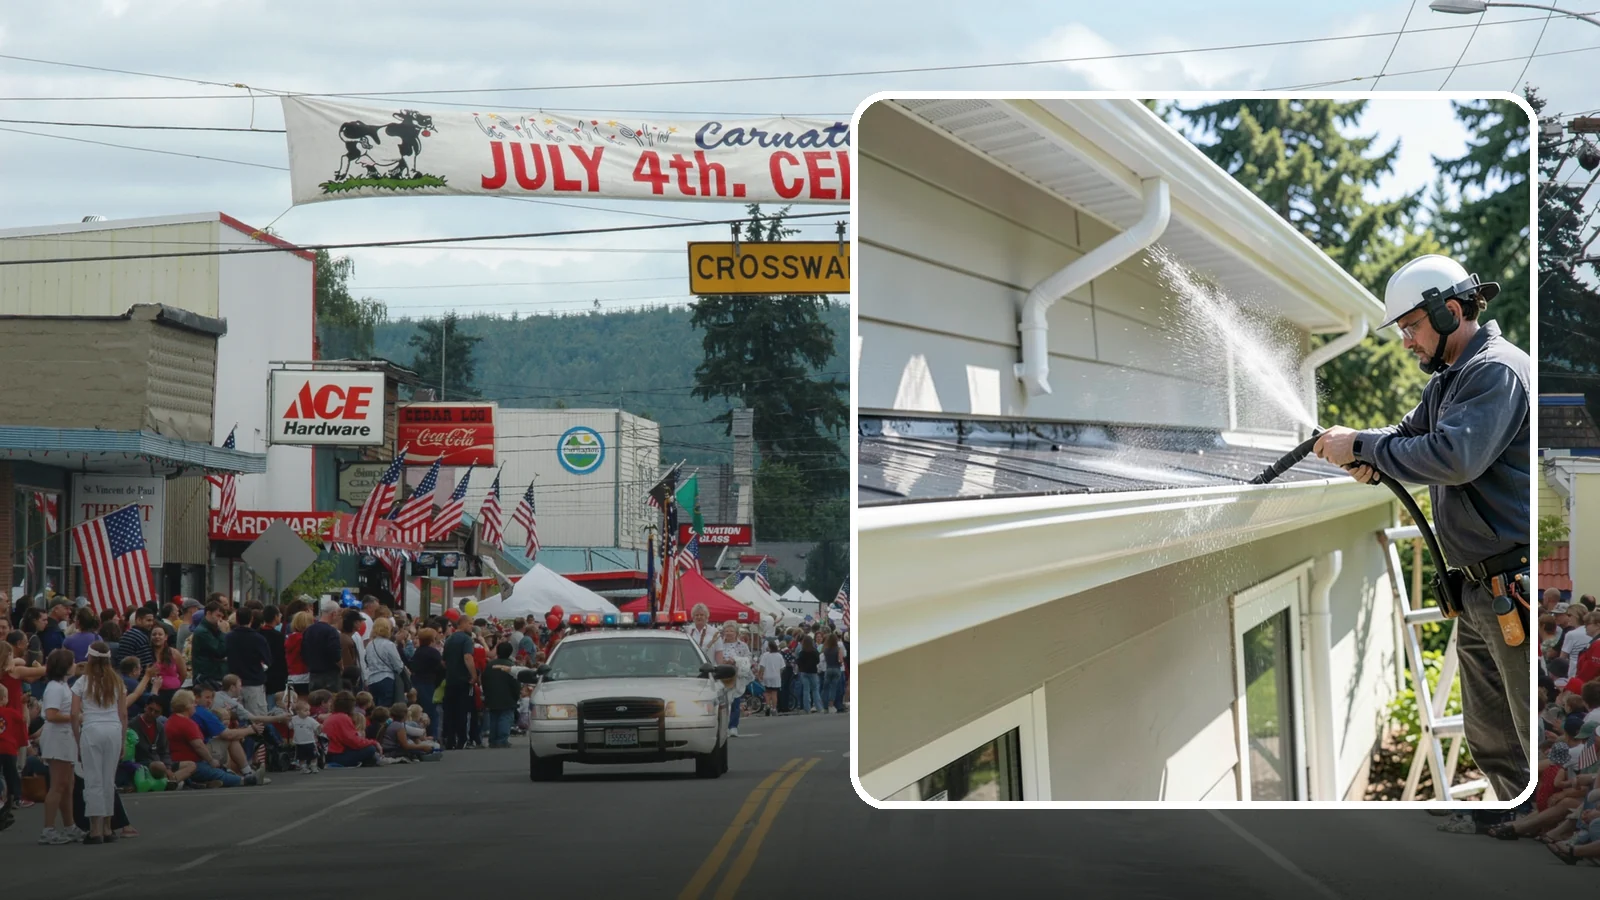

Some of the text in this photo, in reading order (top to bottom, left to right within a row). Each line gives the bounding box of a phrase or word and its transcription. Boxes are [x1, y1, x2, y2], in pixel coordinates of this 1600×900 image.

[481, 141, 604, 192] JULY
[632, 150, 746, 197] 4th.
[696, 254, 850, 280] CROSSWA
[283, 380, 373, 420] ACE
[405, 409, 453, 422] CEDAR
[283, 421, 371, 437] Hardware
[416, 428, 477, 447] Coca-Cola
[82, 486, 155, 496] St. Vincent de Paul
[212, 515, 331, 535] HARDARE
[688, 526, 741, 535] CRNATION
[698, 535, 730, 543] GLASS
